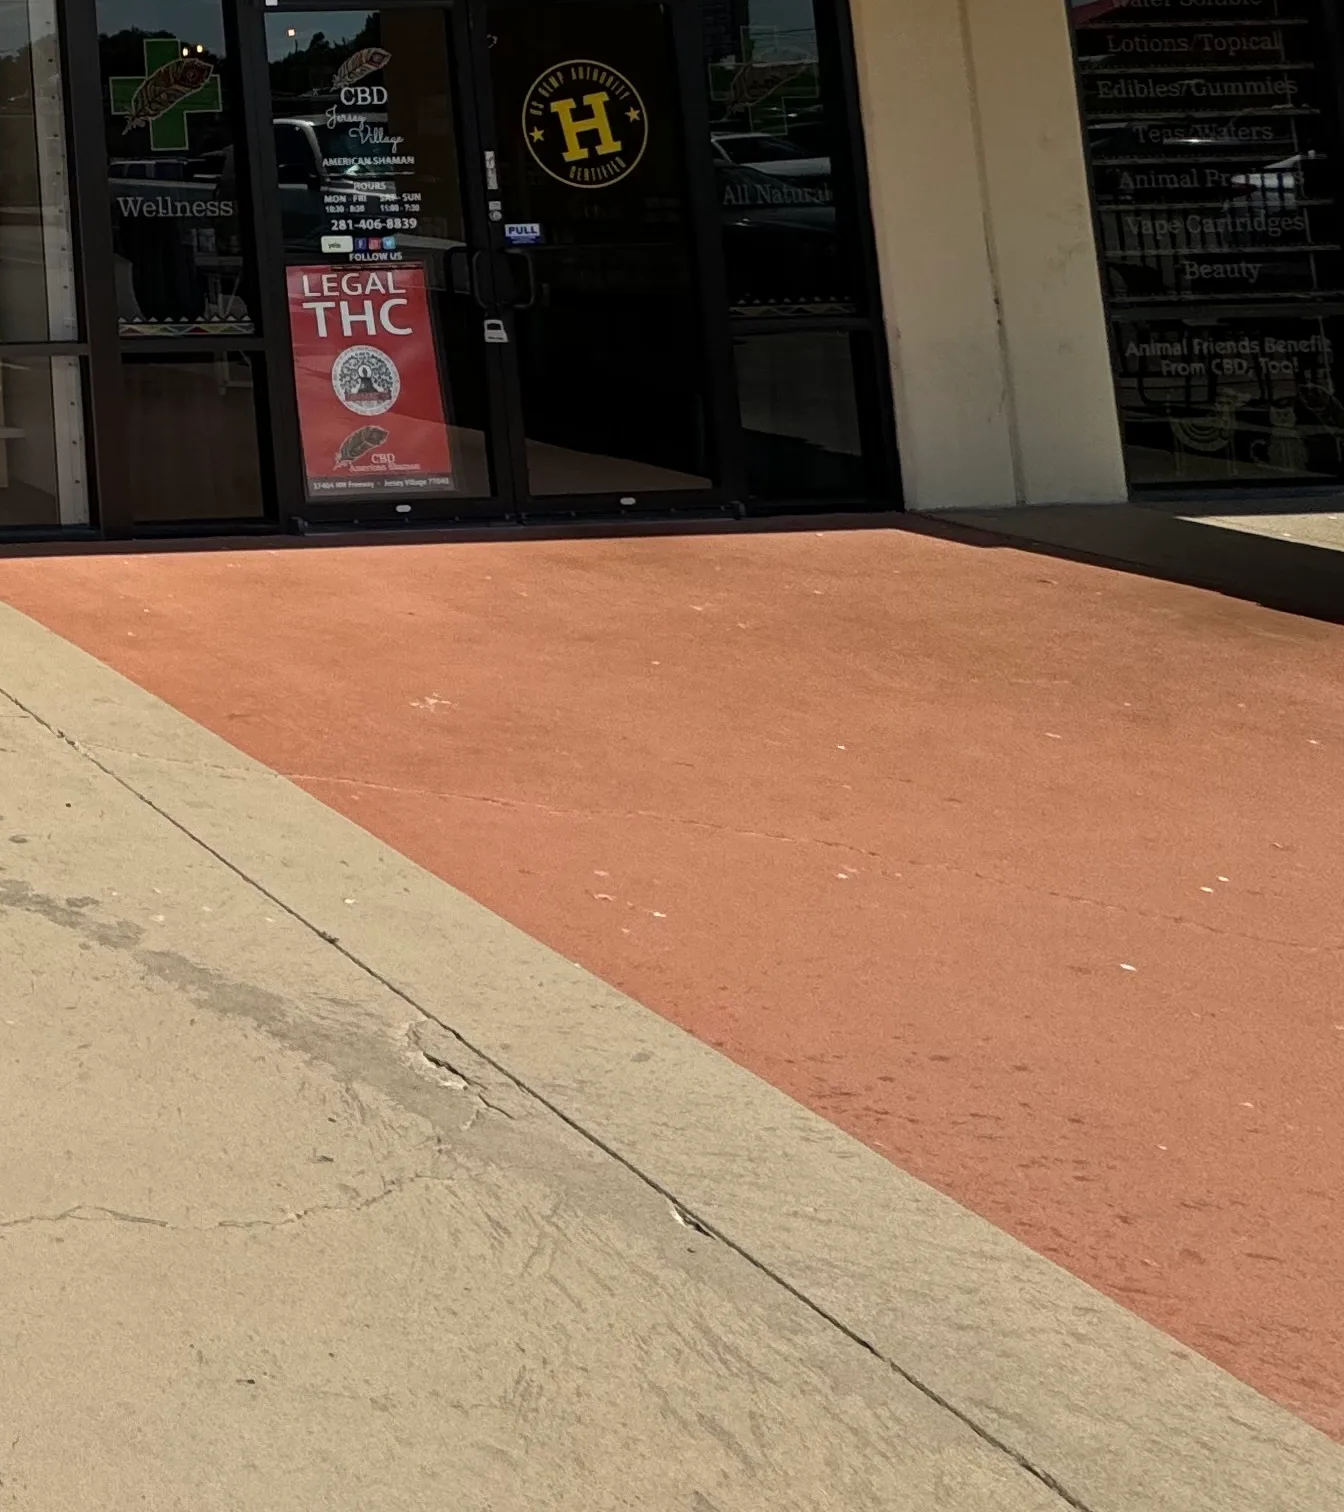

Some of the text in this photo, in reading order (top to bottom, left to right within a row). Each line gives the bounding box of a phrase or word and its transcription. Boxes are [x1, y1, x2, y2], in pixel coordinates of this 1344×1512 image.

[340, 86, 388, 106] CBD
[325, 105, 366, 130] Jersey
[550, 91, 623, 163] H
[349, 125, 404, 154] Village
[322, 156, 415, 167] AMERICAN SHAMAN
[352, 181, 387, 191] HOURS
[1118, 169, 1199, 189] Animal
[324, 195, 347, 204] MON
[353, 194, 367, 203] FRI
[402, 193, 422, 202] SUN
[722, 181, 835, 206] All Natural
[117, 196, 234, 218] Wellness
[331, 218, 417, 231] 281-406-8839
[508, 226, 538, 235] PULL
[1124, 209, 1305, 239] Vape Cartridges
[349, 251, 403, 262] FOLLOW US
[1183, 260, 1264, 284] Beauty
[302, 271, 406, 297] LEGAL
[302, 298, 413, 338] THC
[1125, 340, 1188, 358] Animal
[1192, 337, 1260, 355] Friends
[1162, 357, 1300, 377] From CBD, Too!
[371, 453, 395, 464] CBD
